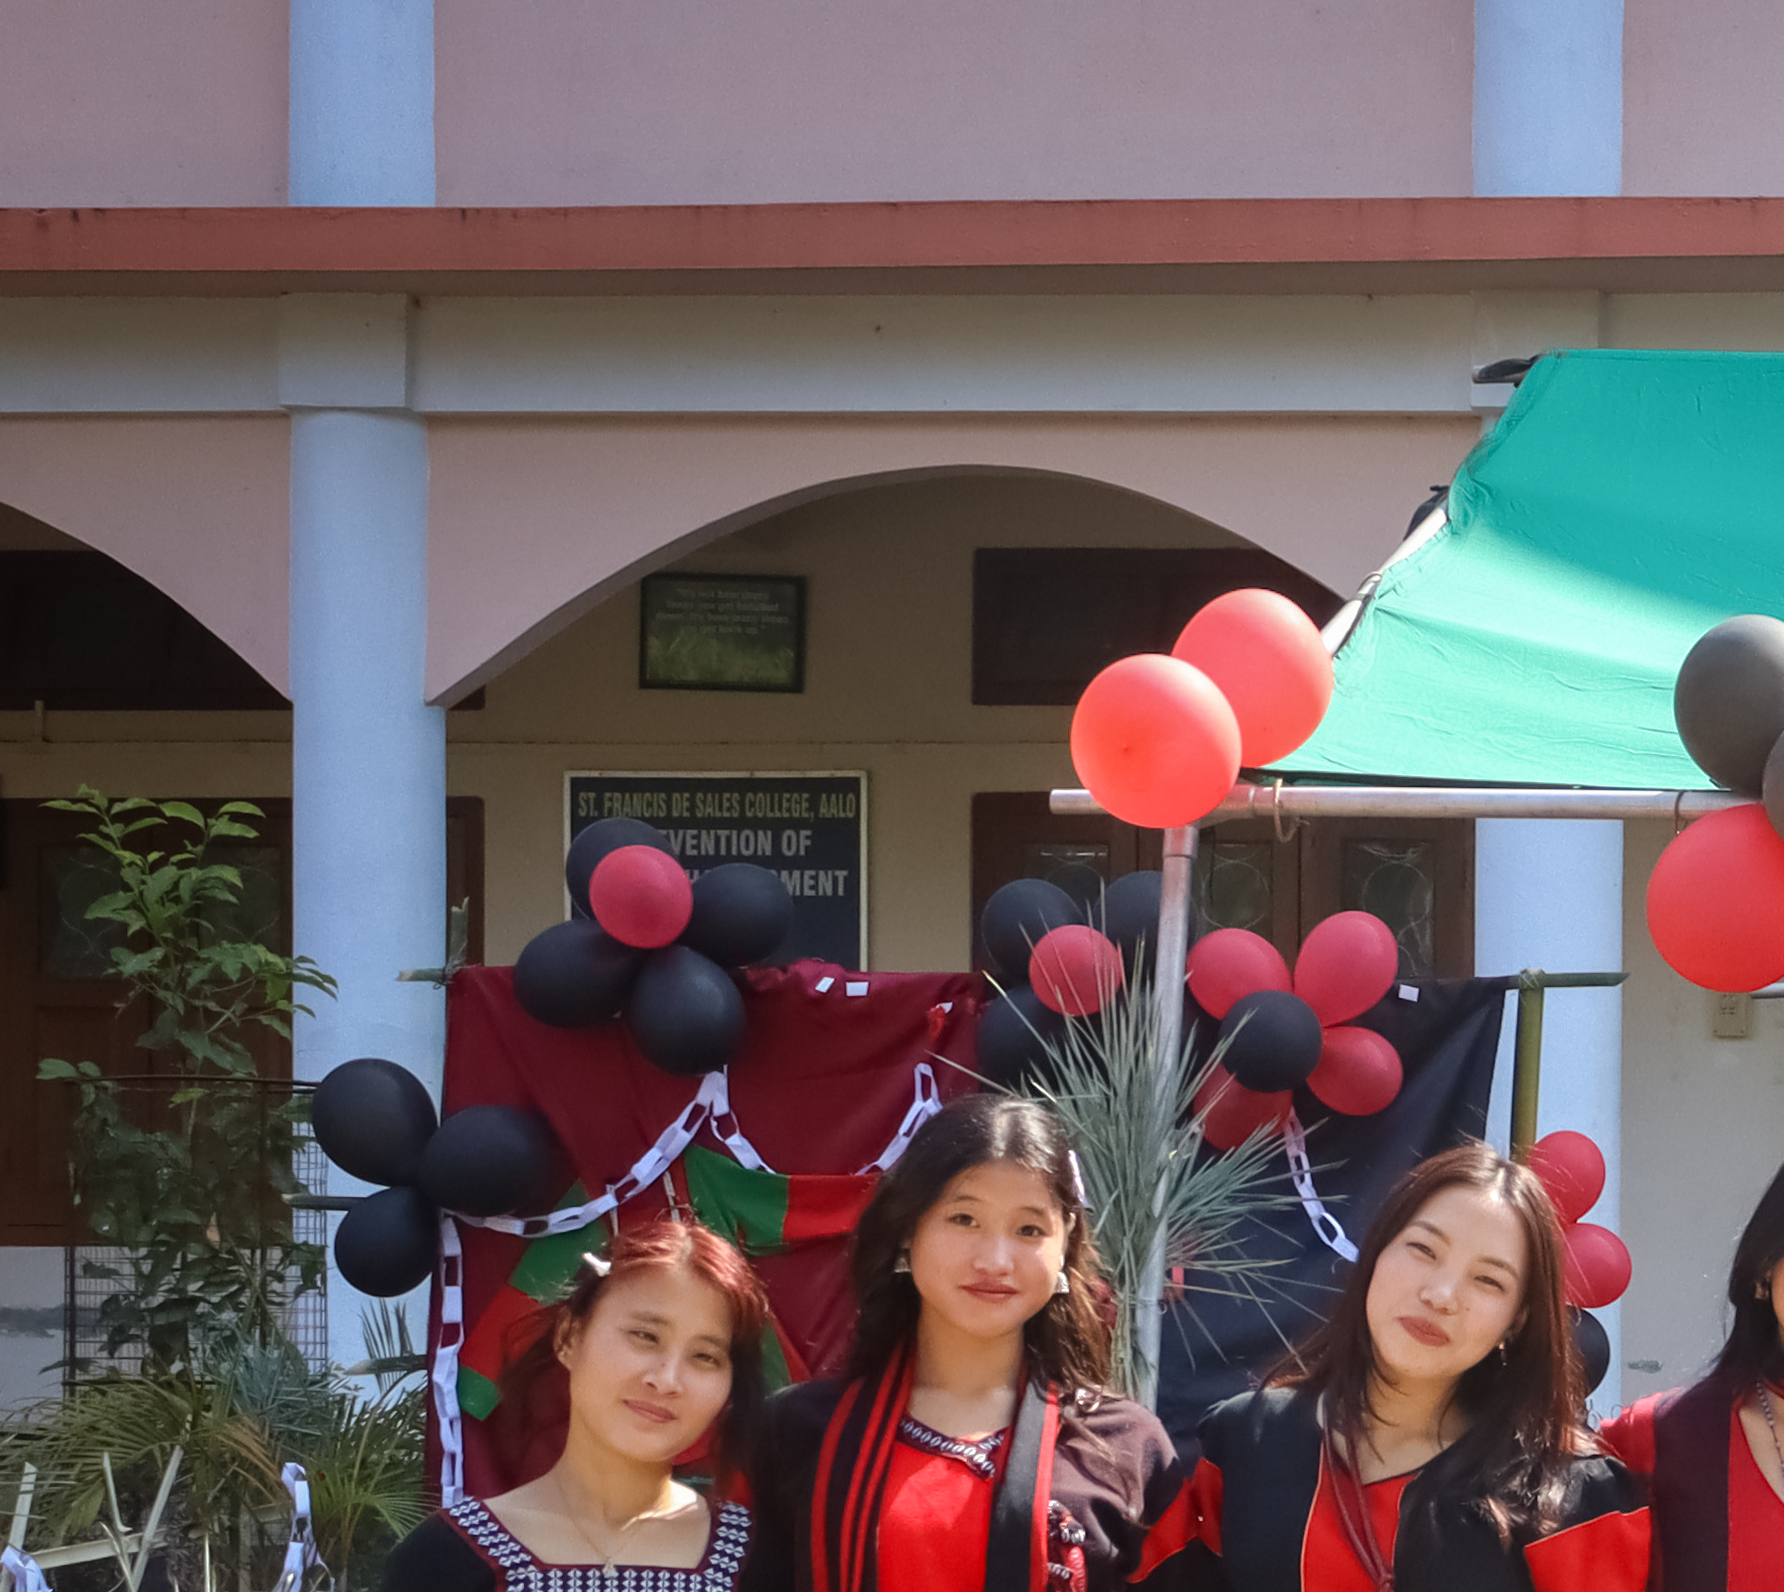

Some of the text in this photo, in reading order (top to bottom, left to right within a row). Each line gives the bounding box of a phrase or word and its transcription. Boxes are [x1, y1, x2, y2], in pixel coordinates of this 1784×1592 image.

[578, 792, 856, 822] ST. FRANCIS DE SALES COLLEGE, AALO
[781, 829, 813, 857] OF
